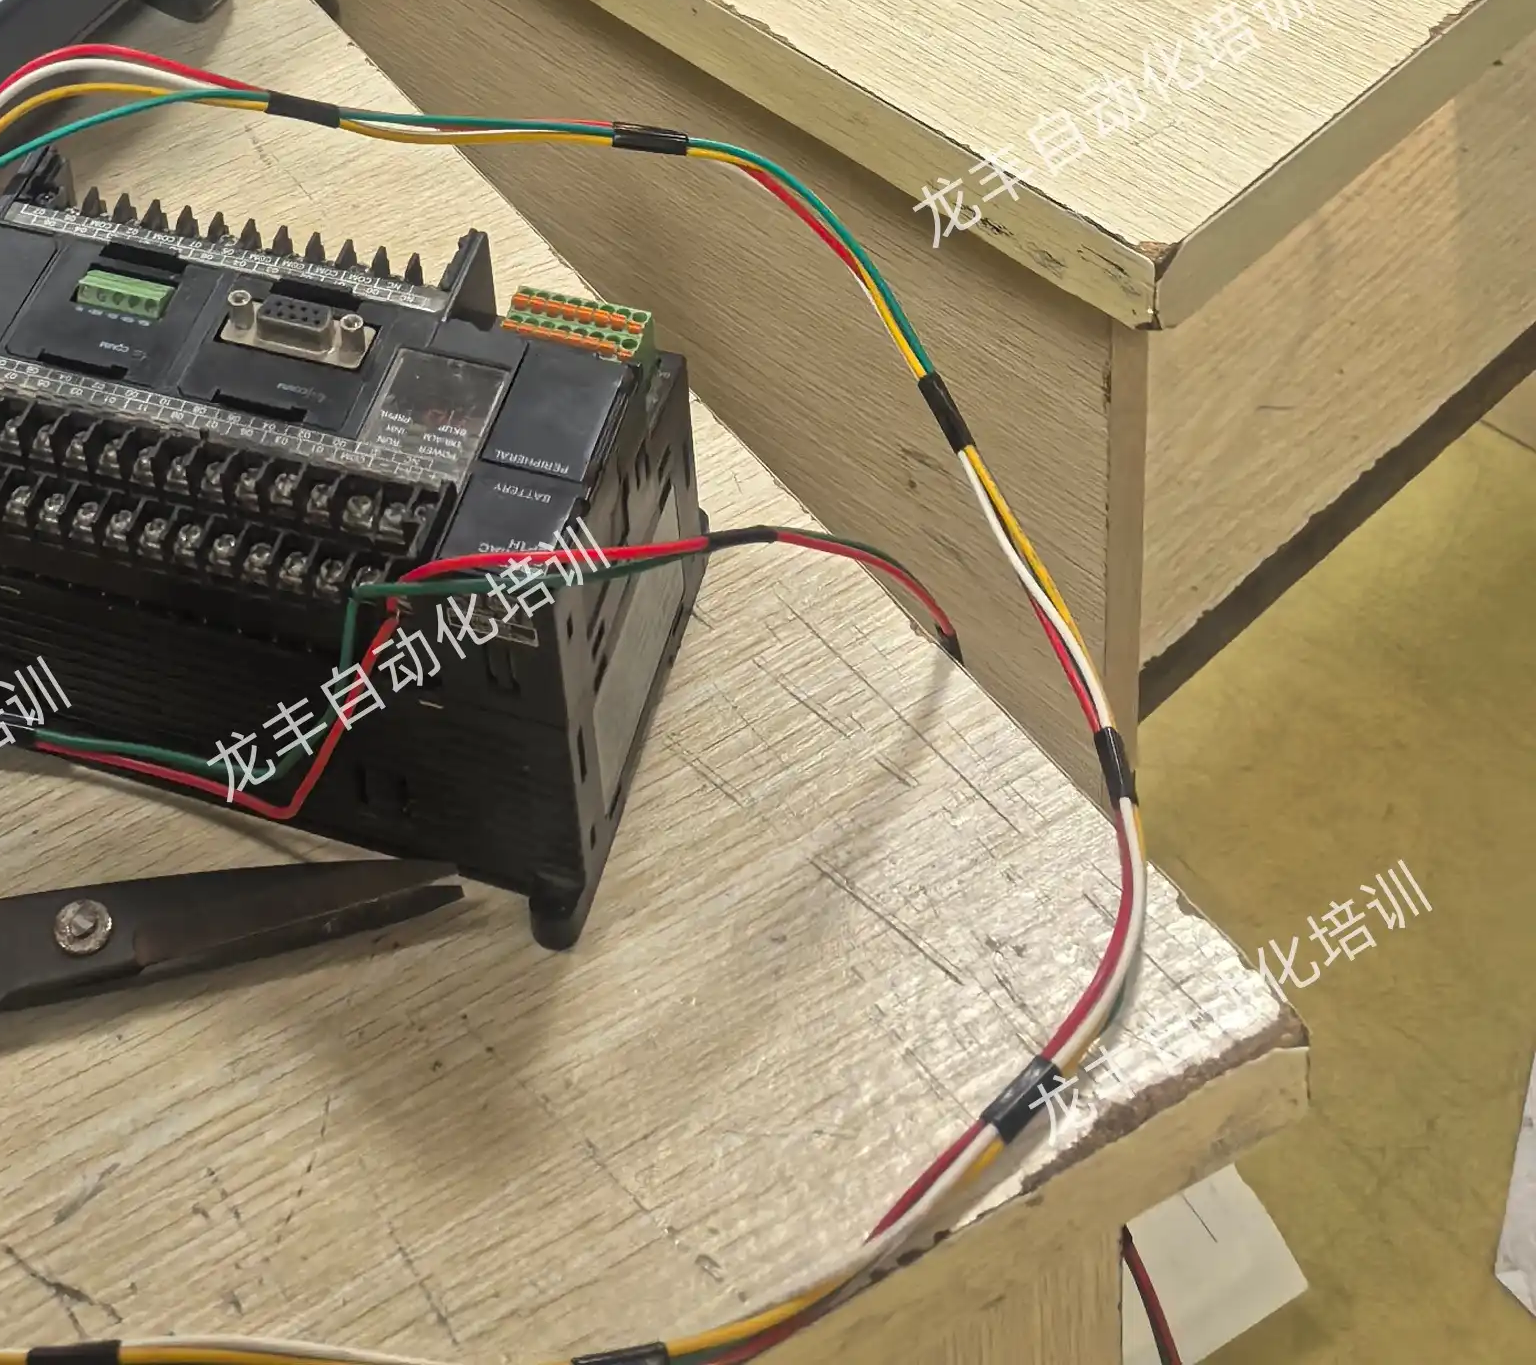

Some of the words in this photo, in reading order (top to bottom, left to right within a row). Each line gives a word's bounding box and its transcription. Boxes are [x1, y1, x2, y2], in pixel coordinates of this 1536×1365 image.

[91, 221, 112, 229] COM
[153, 234, 174, 243] COM
[349, 274, 372, 284] COM
[494, 448, 570, 475] PERIPHERAL
[493, 482, 553, 504] BATTERY
